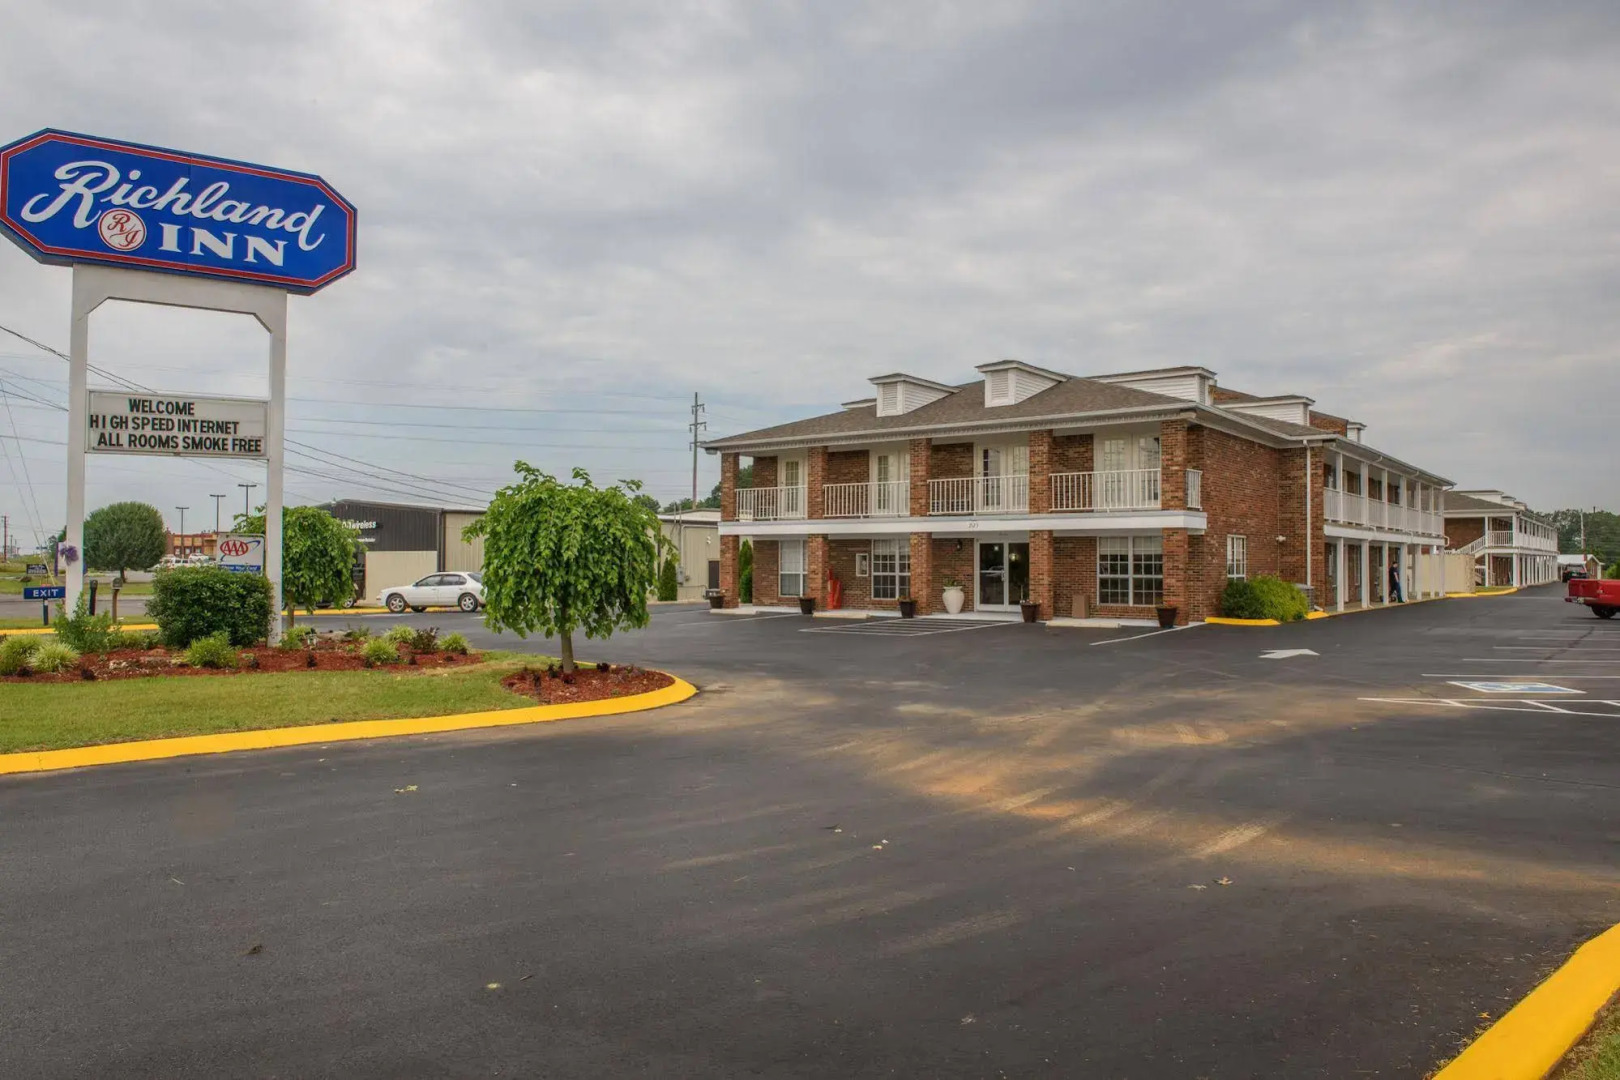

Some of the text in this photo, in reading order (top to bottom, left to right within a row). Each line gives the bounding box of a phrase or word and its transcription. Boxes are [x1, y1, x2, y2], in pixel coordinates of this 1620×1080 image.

[20, 160, 326, 252] Richland
[158, 222, 289, 267] INN
[128, 398, 195, 416] WELCOME
[131, 416, 175, 432] SPEED
[177, 419, 240, 435] INTERNET
[97, 432, 262, 453] ALL ROOMS SMOKE FREE
[223, 540, 246, 556] AAA
[32, 588, 59, 598] EXIT
